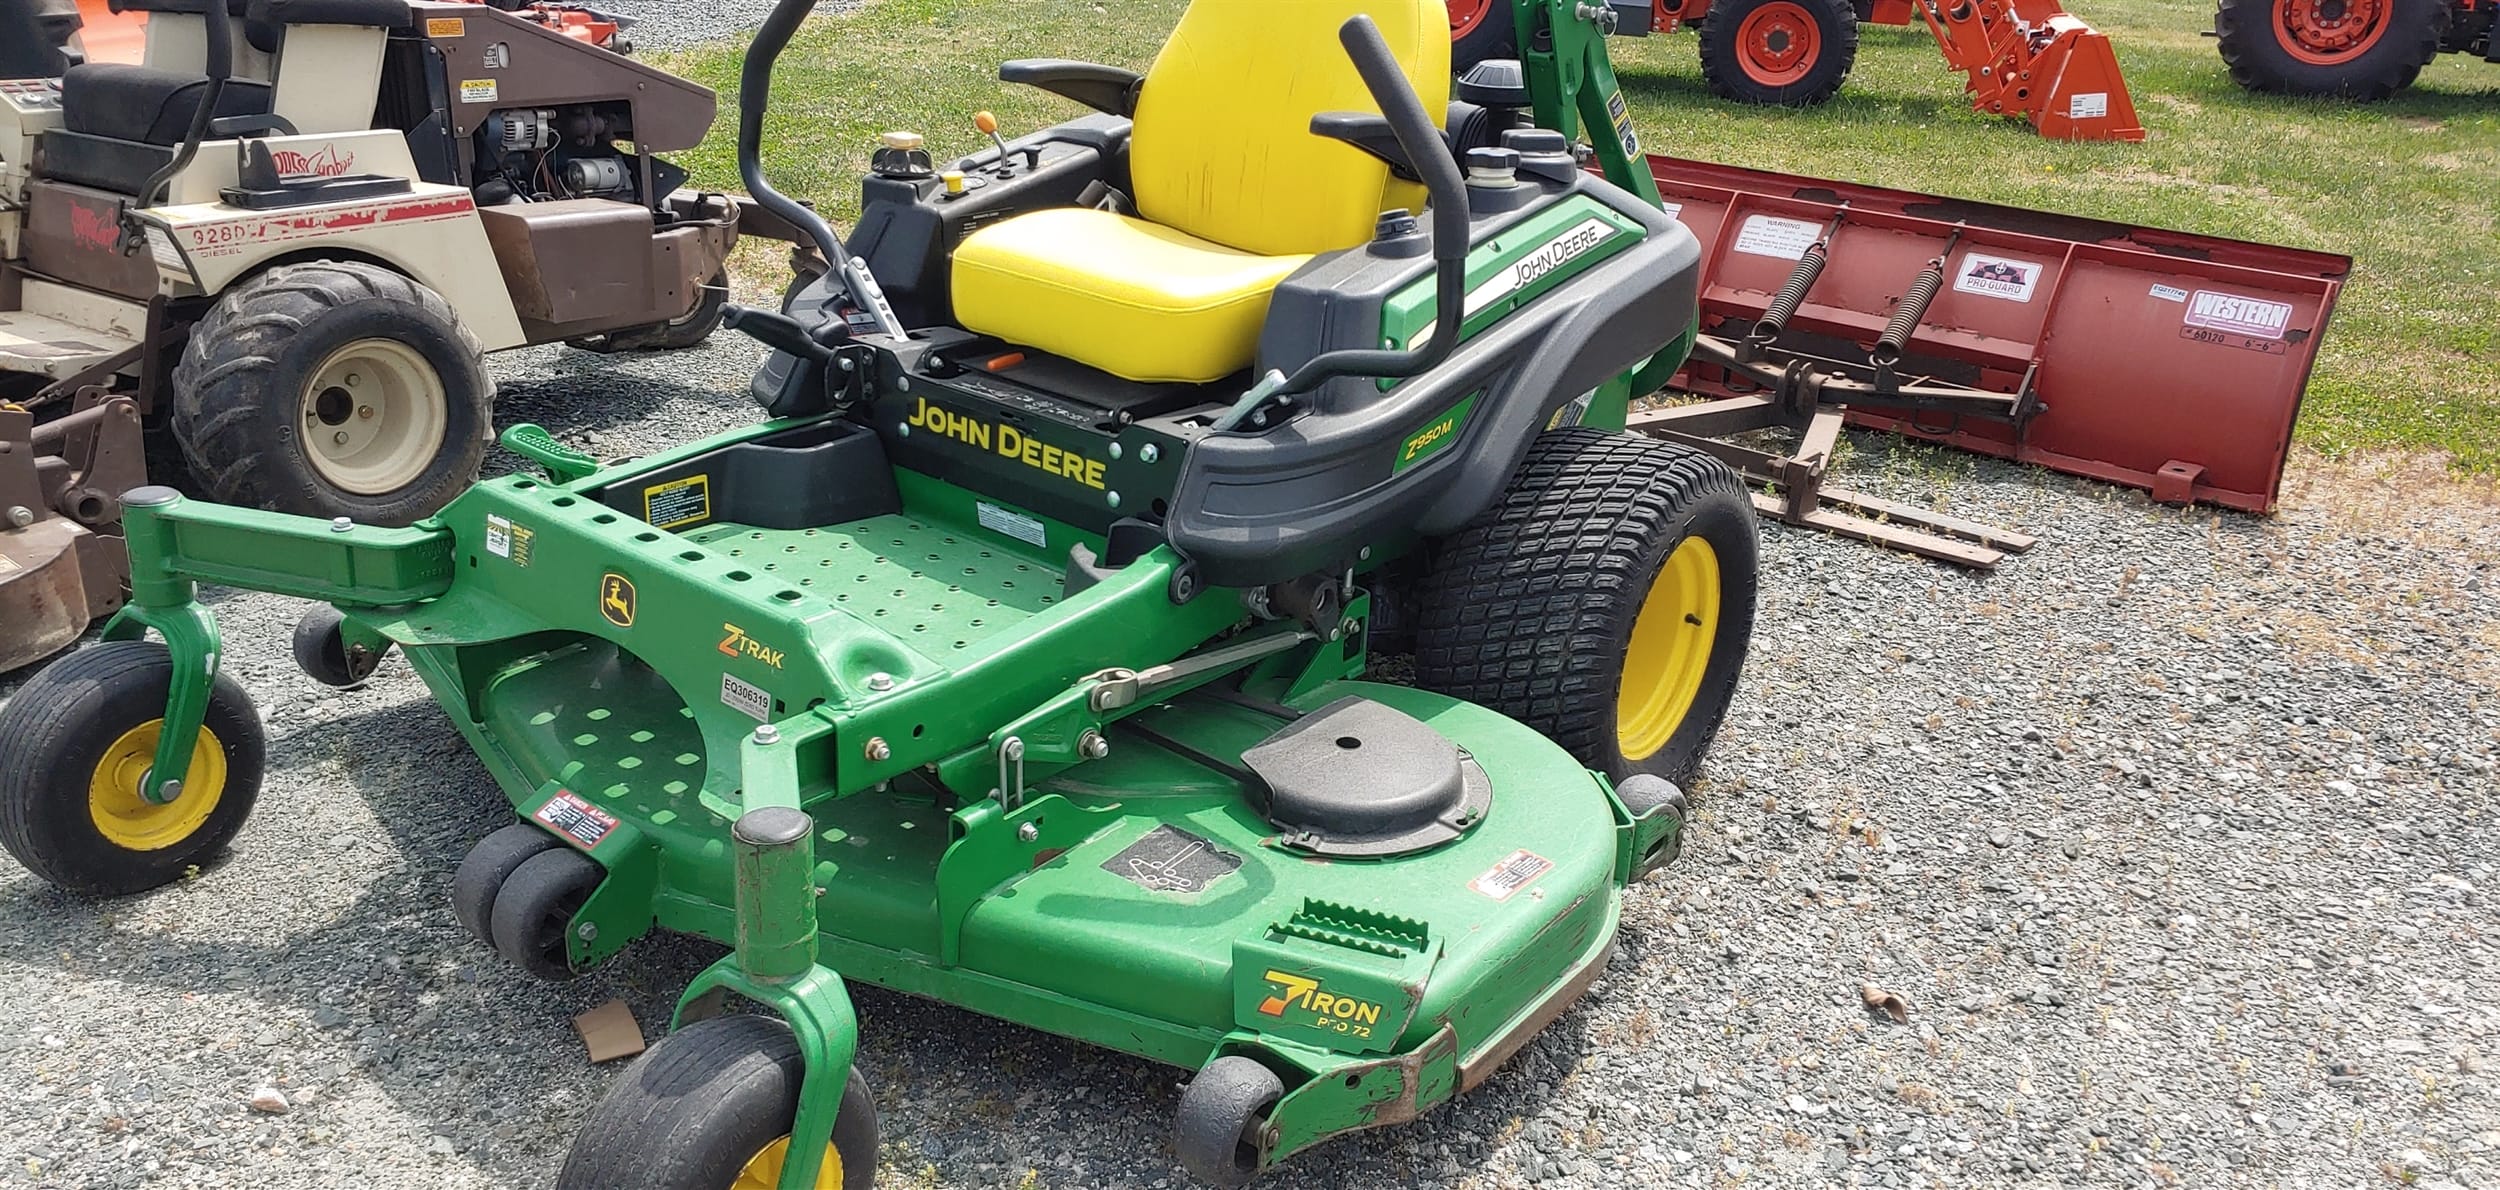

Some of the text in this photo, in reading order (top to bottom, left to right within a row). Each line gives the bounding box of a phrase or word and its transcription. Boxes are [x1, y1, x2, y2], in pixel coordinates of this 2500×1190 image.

[1767, 219, 1801, 230] WARNING
[201, 248, 243, 258] DIESEL
[1515, 226, 1598, 286] JOHN DEERE
[2194, 292, 2289, 328] WESTERN
[909, 396, 990, 450] JOHN
[997, 423, 1106, 490] DEERE
[1405, 418, 1453, 461] Z950M
[724, 678, 768, 709] EQ306319
[1352, 1025, 1371, 1038] 72
